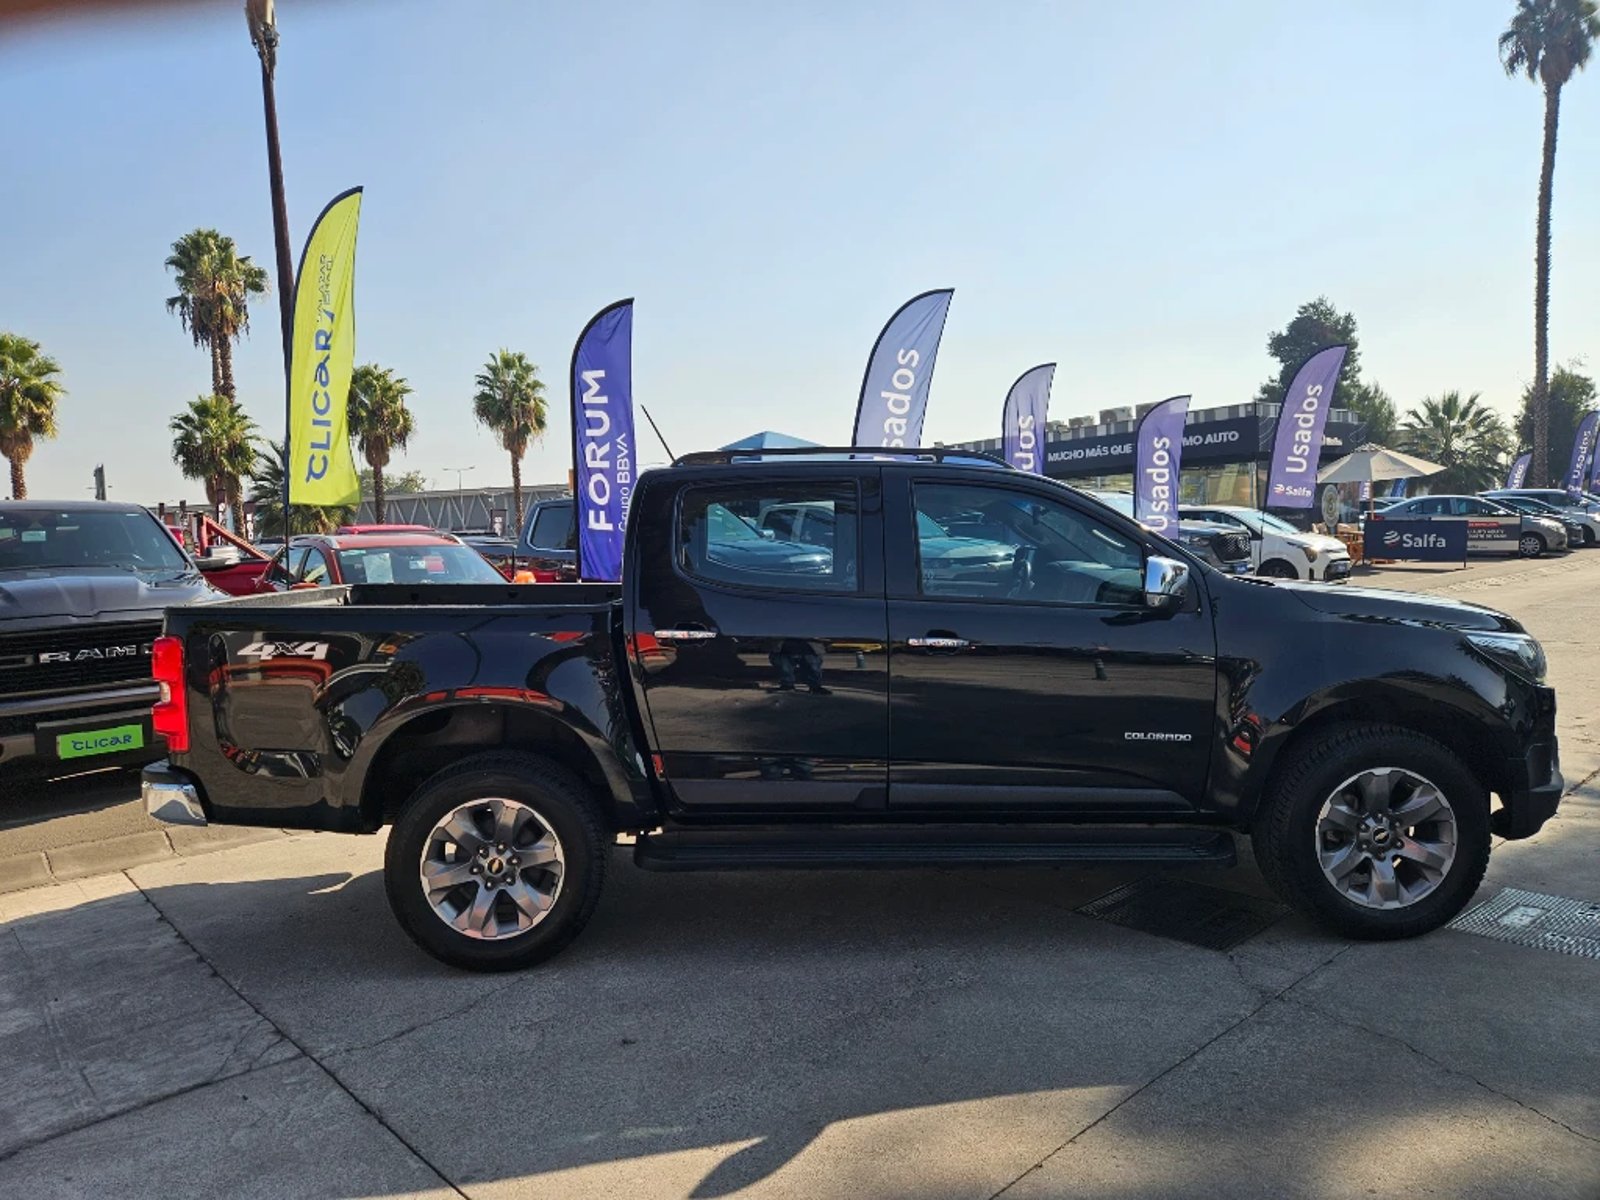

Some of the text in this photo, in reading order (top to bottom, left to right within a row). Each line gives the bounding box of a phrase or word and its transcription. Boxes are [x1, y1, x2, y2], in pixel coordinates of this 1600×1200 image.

[874, 348, 920, 460] sados
[1048, 450, 1084, 463] MUCHO
[1086, 445, 1109, 458] MÁS
[1110, 443, 1133, 455] QUE
[1204, 430, 1240, 444] AUTO
[1285, 384, 1323, 473] Usados
[581, 370, 614, 531] FORUM
[615, 433, 630, 483] BBVA
[1146, 436, 1171, 532] Usados
[1285, 485, 1312, 497] Salfa
[1402, 533, 1446, 548] Salfa
[38, 645, 137, 663] RAM
[1124, 732, 1192, 741] COLORADO
